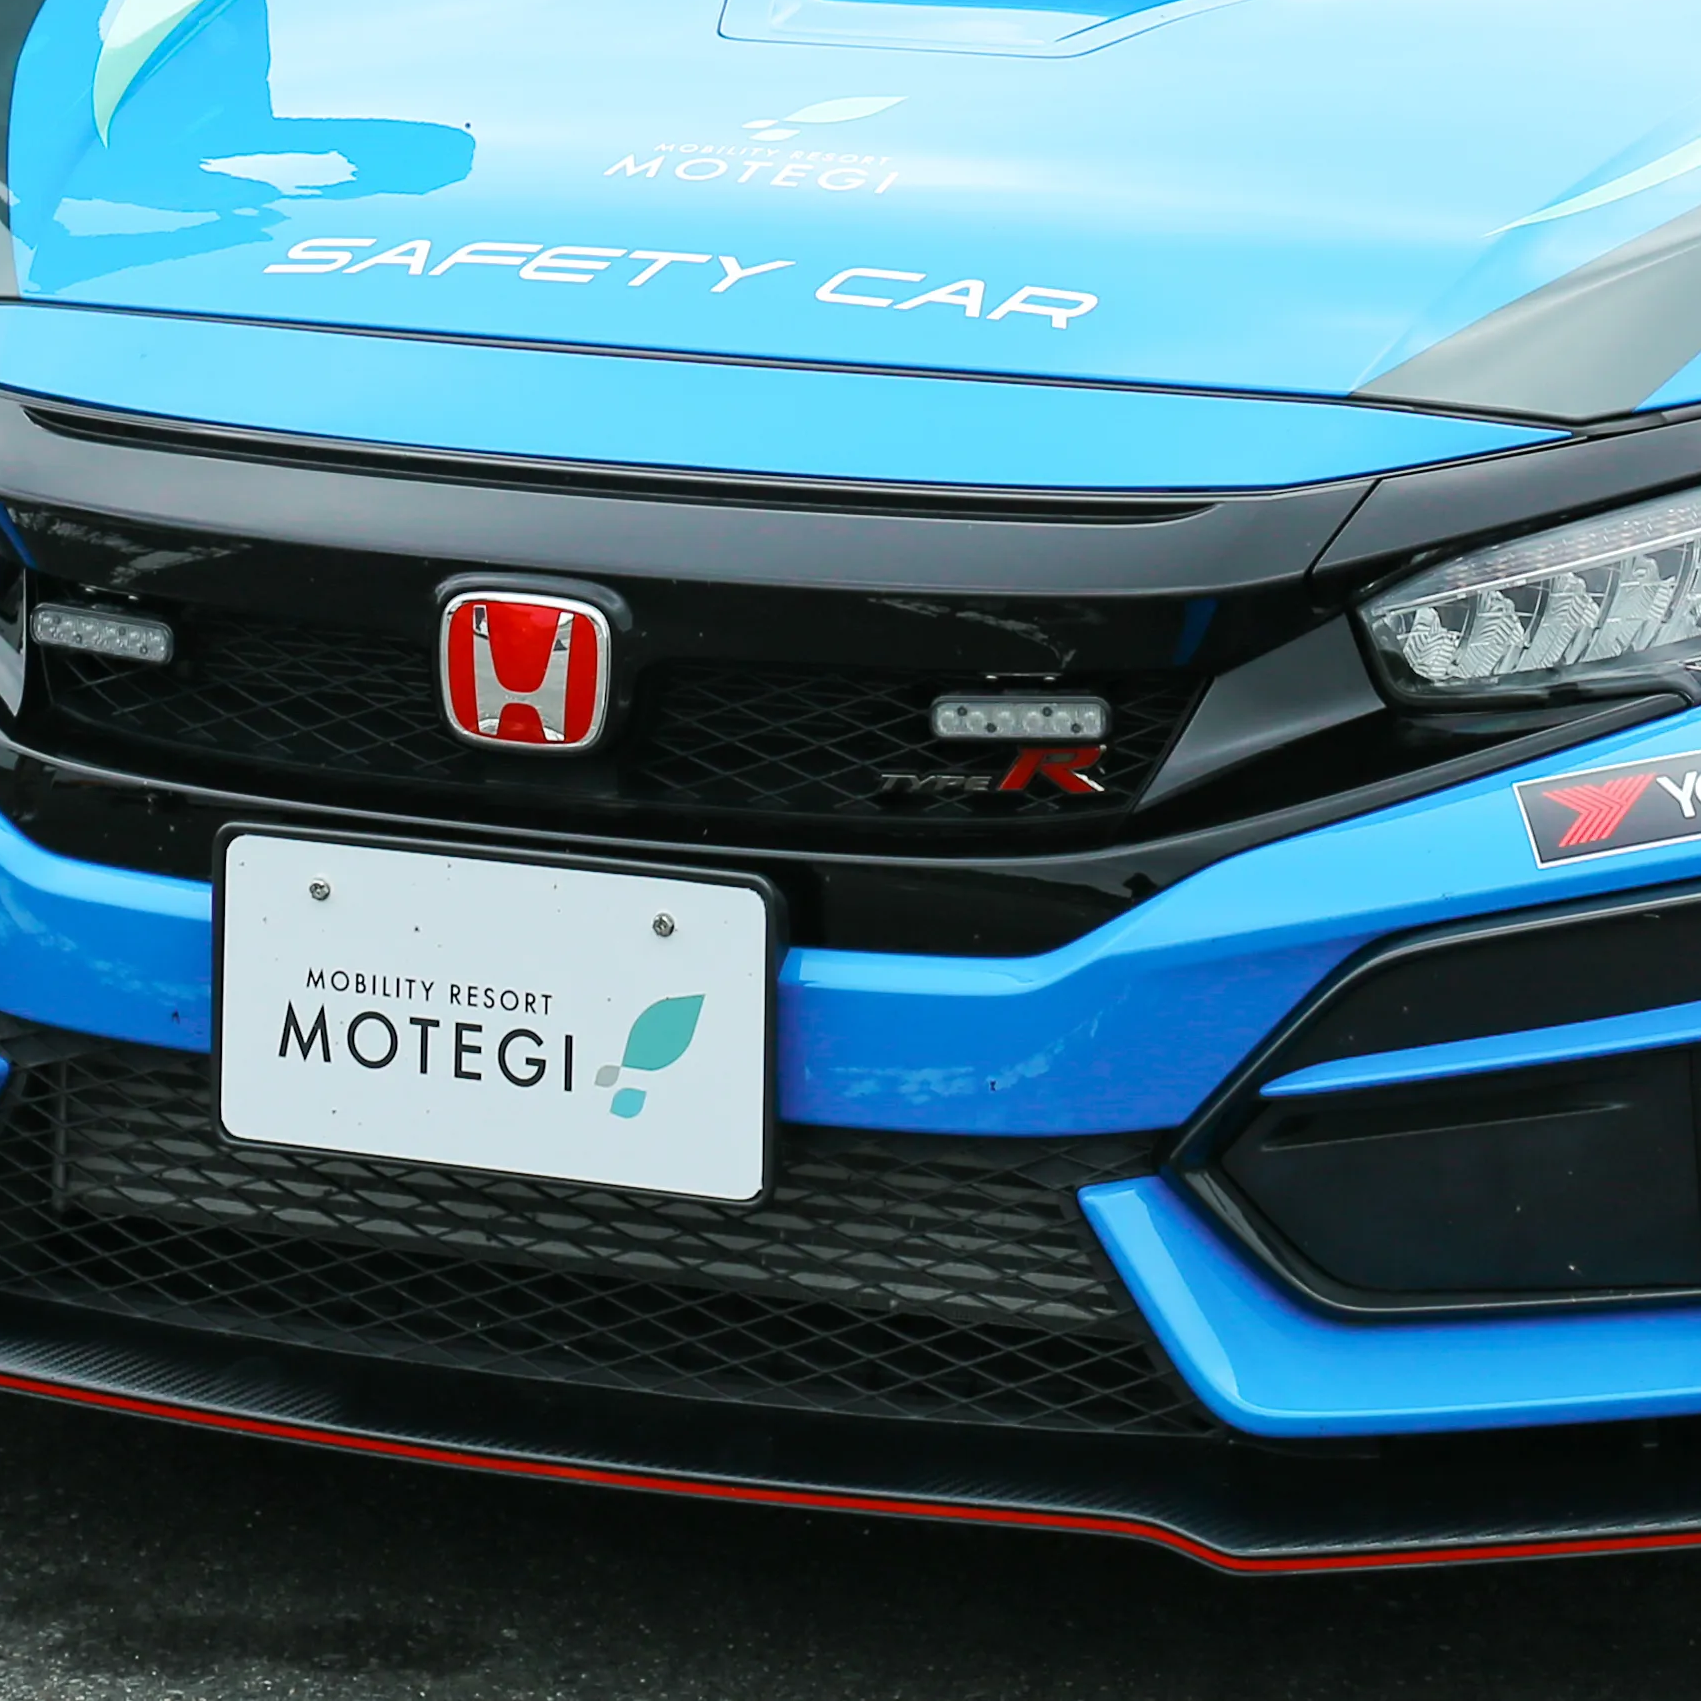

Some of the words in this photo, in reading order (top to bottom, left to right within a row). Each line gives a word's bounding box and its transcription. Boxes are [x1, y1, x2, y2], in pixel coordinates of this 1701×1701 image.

[603, 153, 900, 195] MOTEGI
[654, 143, 780, 158] MOBILITY
[790, 148, 893, 167] RESORT
[263, 237, 797, 293] SAFETY
[814, 267, 1100, 330] CAR
[879, 772, 993, 792] TYPE
[997, 746, 1105, 794] R
[305, 967, 436, 1005] MOBILITY
[449, 983, 554, 1017] RESORT
[278, 999, 575, 1093] MOTEGI
